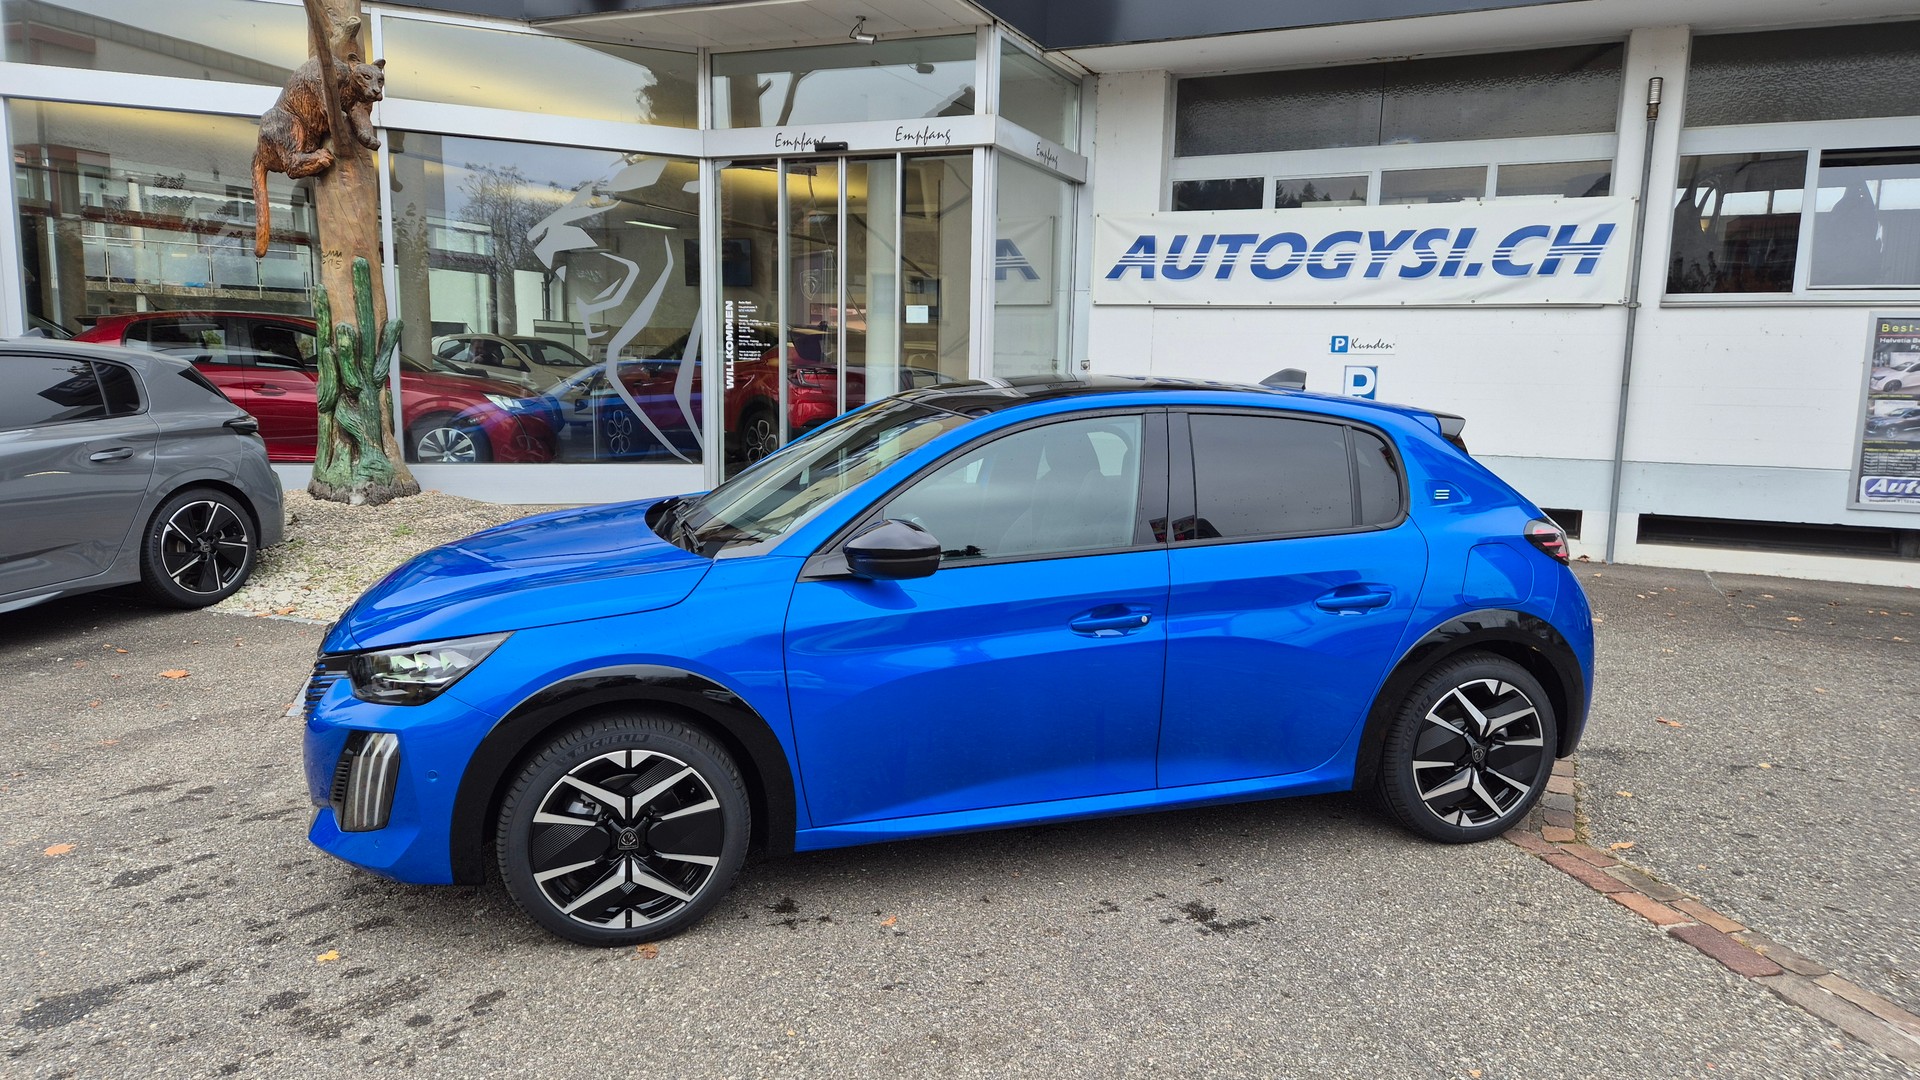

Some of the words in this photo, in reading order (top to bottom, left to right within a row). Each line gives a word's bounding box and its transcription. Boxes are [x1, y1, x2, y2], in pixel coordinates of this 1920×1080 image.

[895, 125, 951, 145] Empfang
[1105, 222, 1617, 281] AUTOGYSI.CH
[725, 300, 735, 390] WILLKOMMEN
[1334, 337, 1346, 351] P
[1350, 338, 1393, 349] Kunden
[573, 733, 648, 757] MICHELIN
